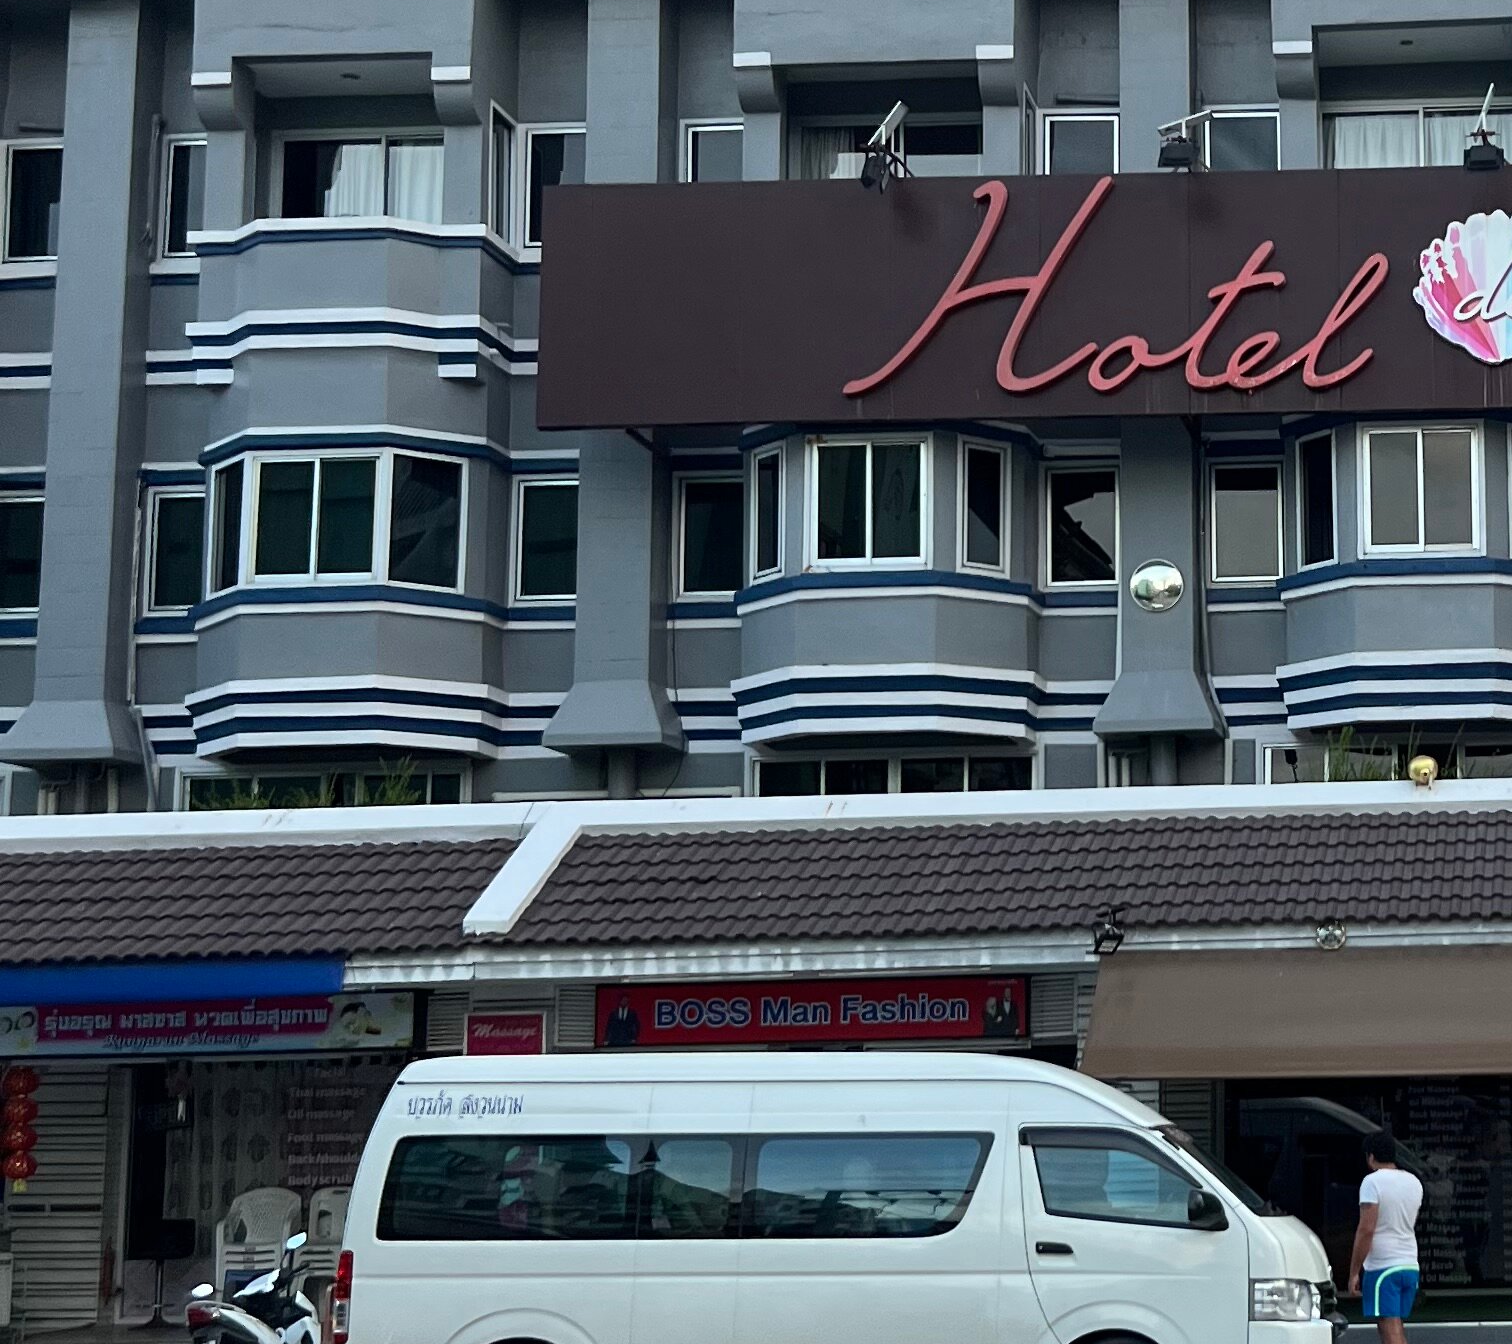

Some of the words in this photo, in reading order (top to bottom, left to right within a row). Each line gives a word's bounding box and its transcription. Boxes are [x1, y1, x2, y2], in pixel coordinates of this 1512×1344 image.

[845, 177, 1389, 393] Hotel
[654, 997, 751, 1029] BOSS
[760, 997, 831, 1026] Man
[839, 993, 970, 1025] Fashion
[472, 1023, 538, 1041] Massage
